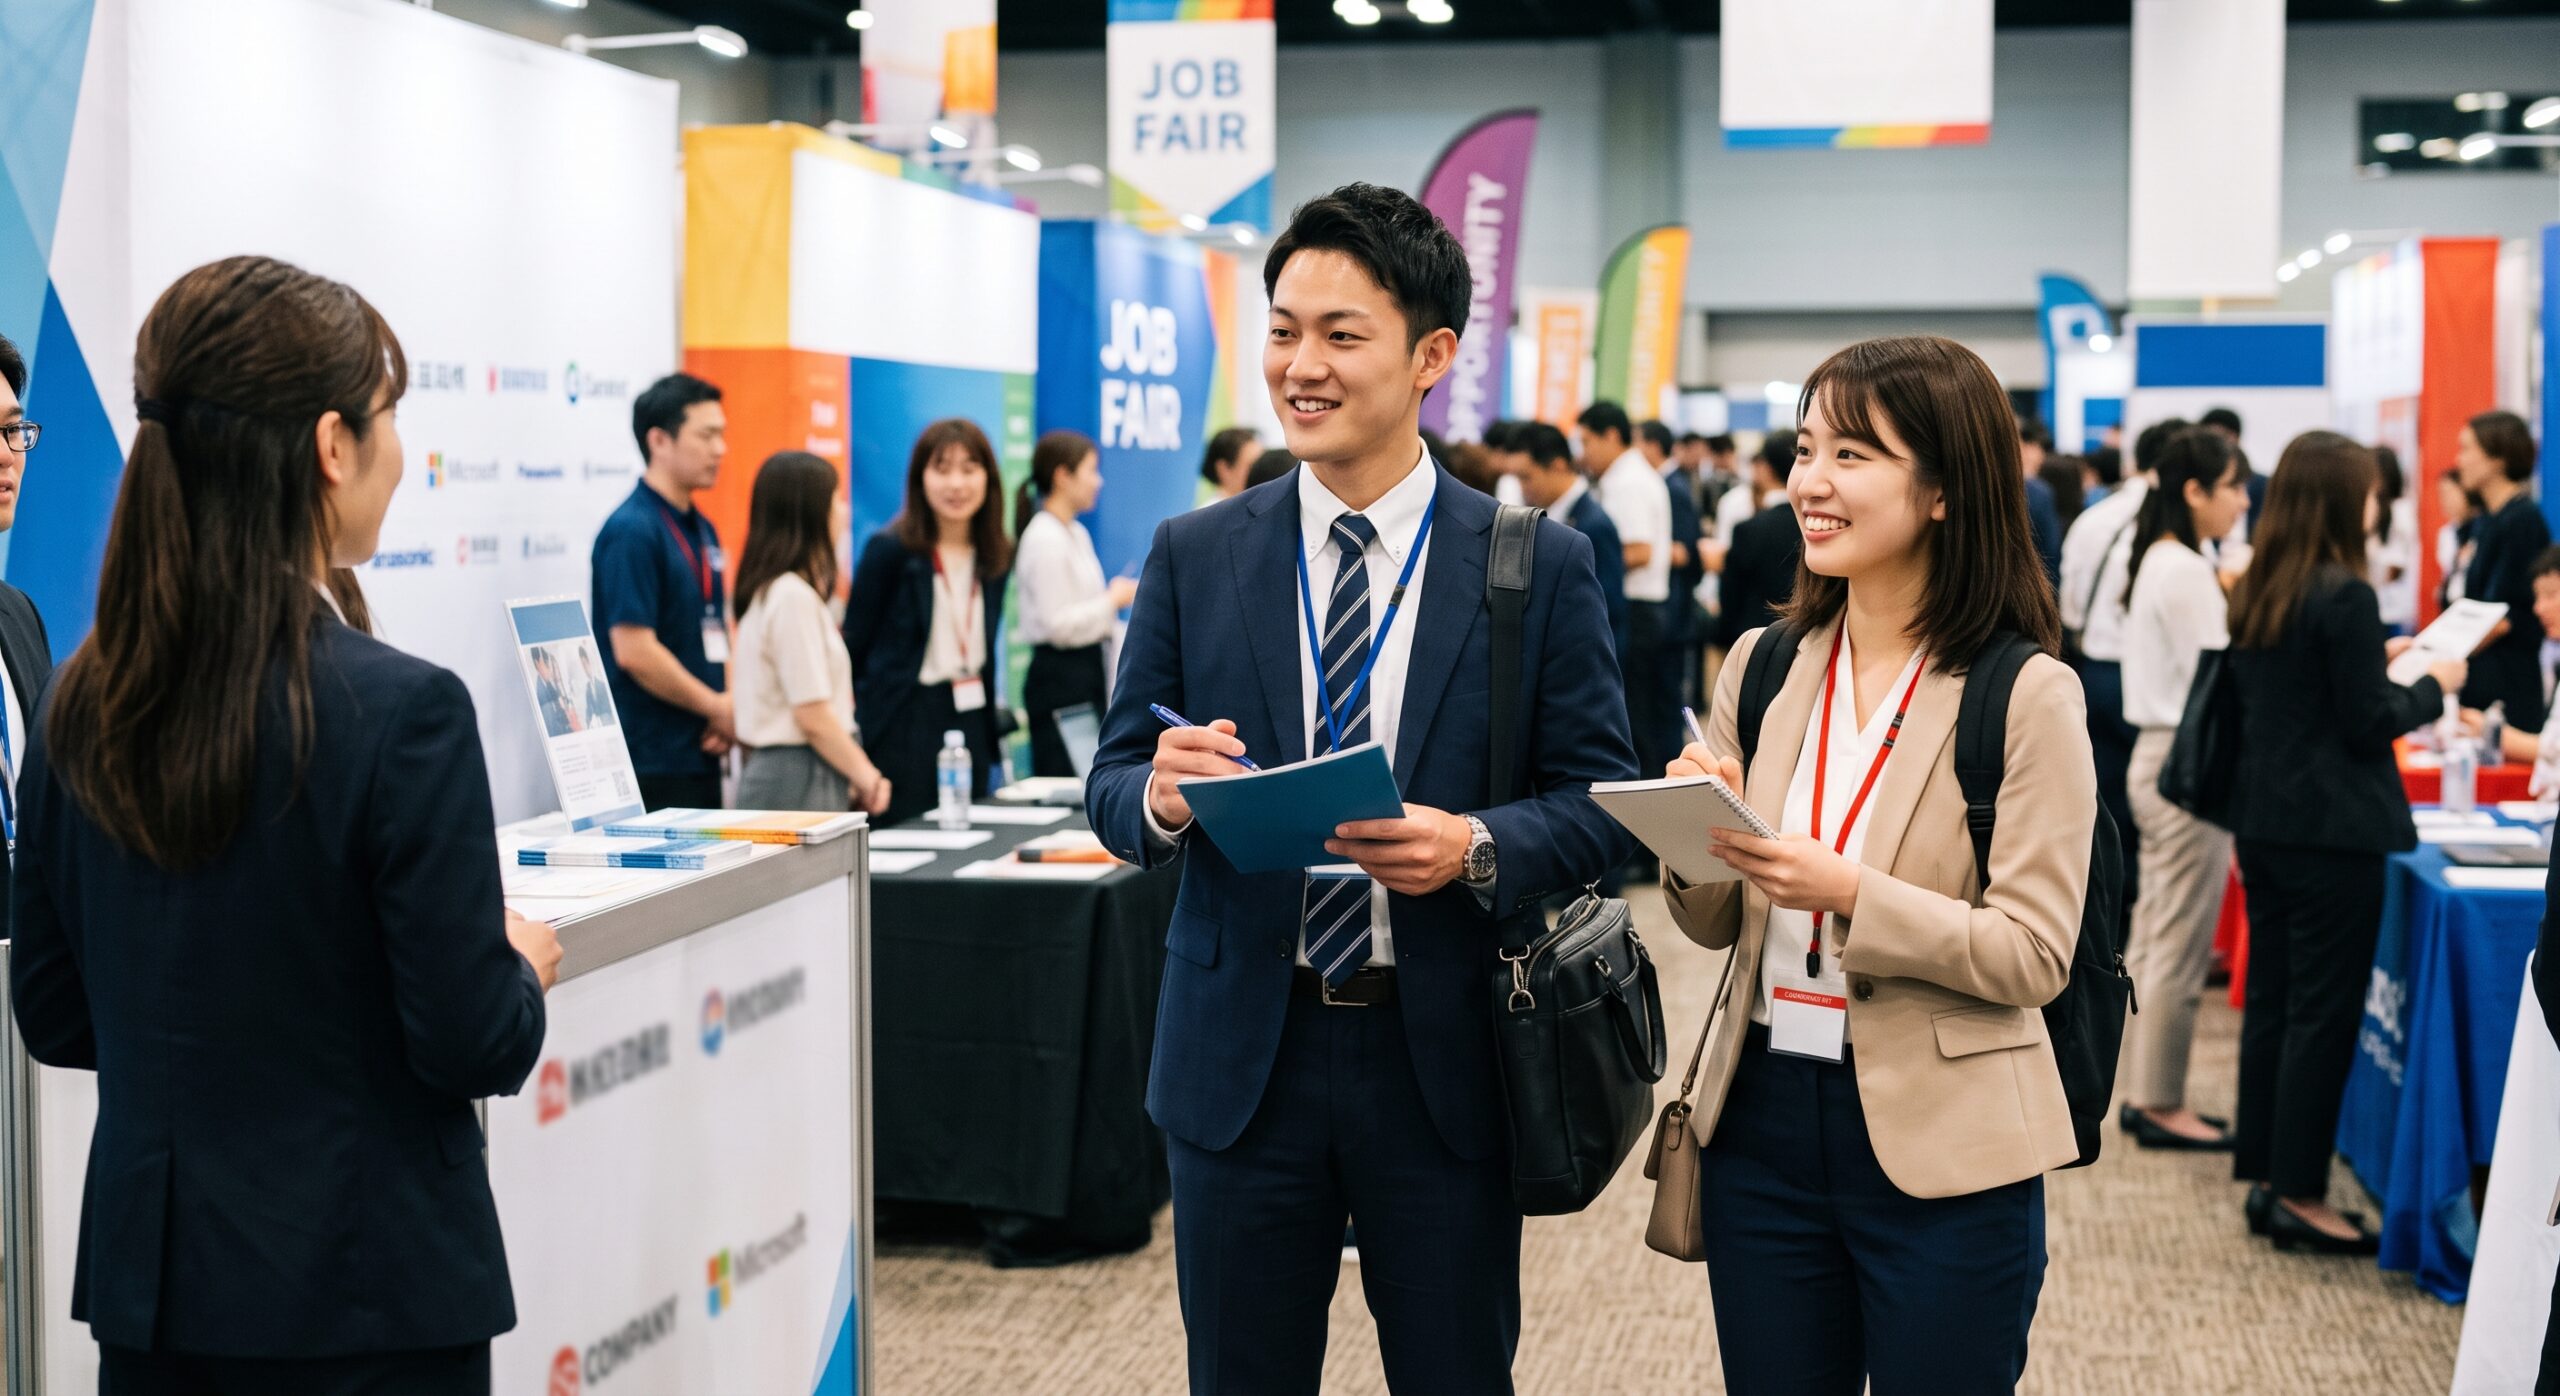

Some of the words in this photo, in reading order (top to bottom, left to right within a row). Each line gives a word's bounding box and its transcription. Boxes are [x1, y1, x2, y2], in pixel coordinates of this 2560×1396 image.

[1139, 58, 1243, 100] JOB
[1134, 112, 1246, 152] FAIR
[1100, 300, 1178, 376] JOB
[1100, 379, 1182, 450] FAIR
[584, 1294, 678, 1386] COMPANY
